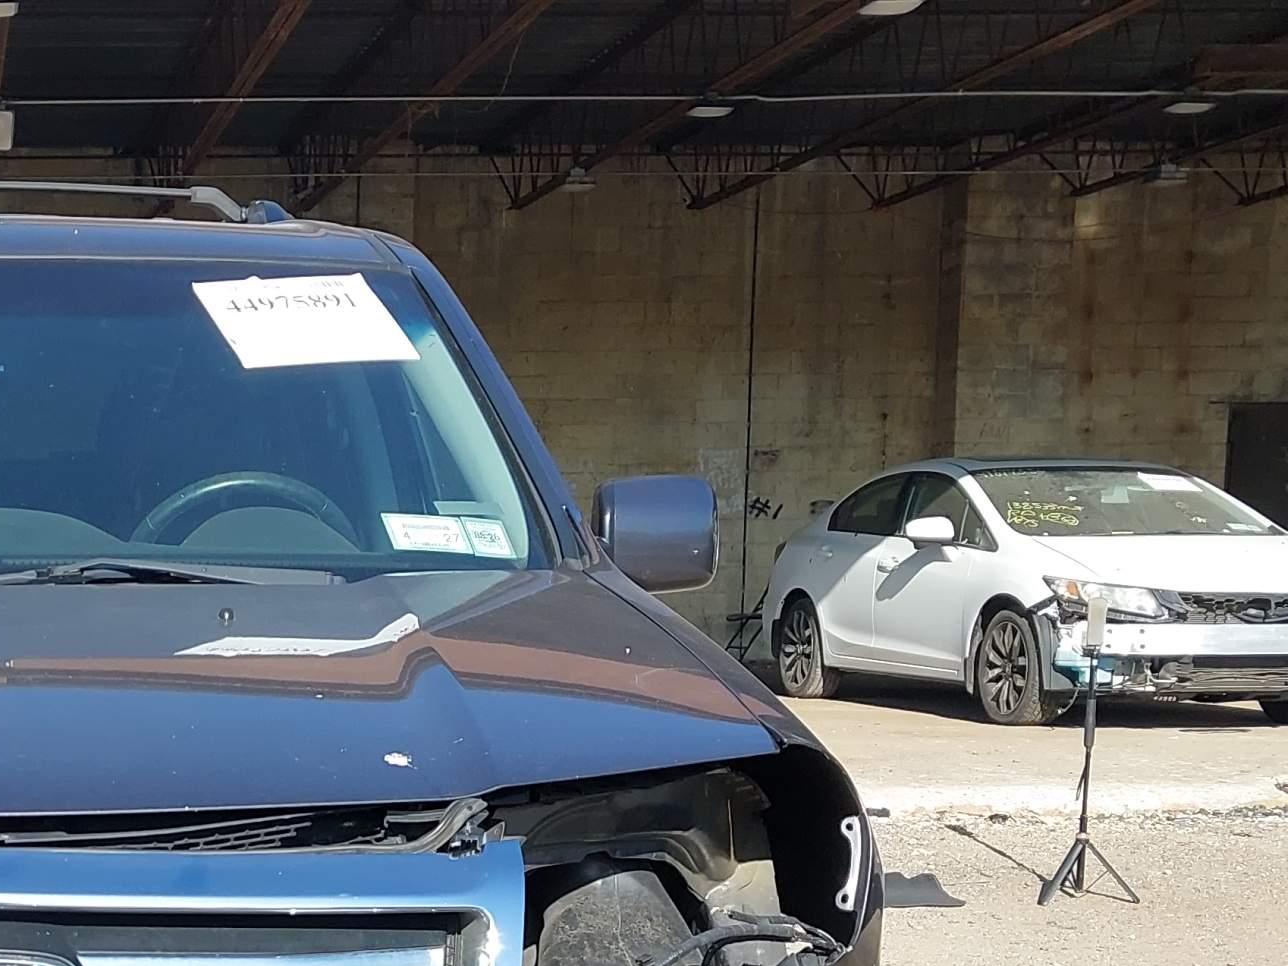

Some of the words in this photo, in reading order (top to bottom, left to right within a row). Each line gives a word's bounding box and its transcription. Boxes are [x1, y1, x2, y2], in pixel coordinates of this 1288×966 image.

[227, 292, 358, 313] 44975891
[749, 497, 783, 519] #1
[443, 533, 459, 543] 27
